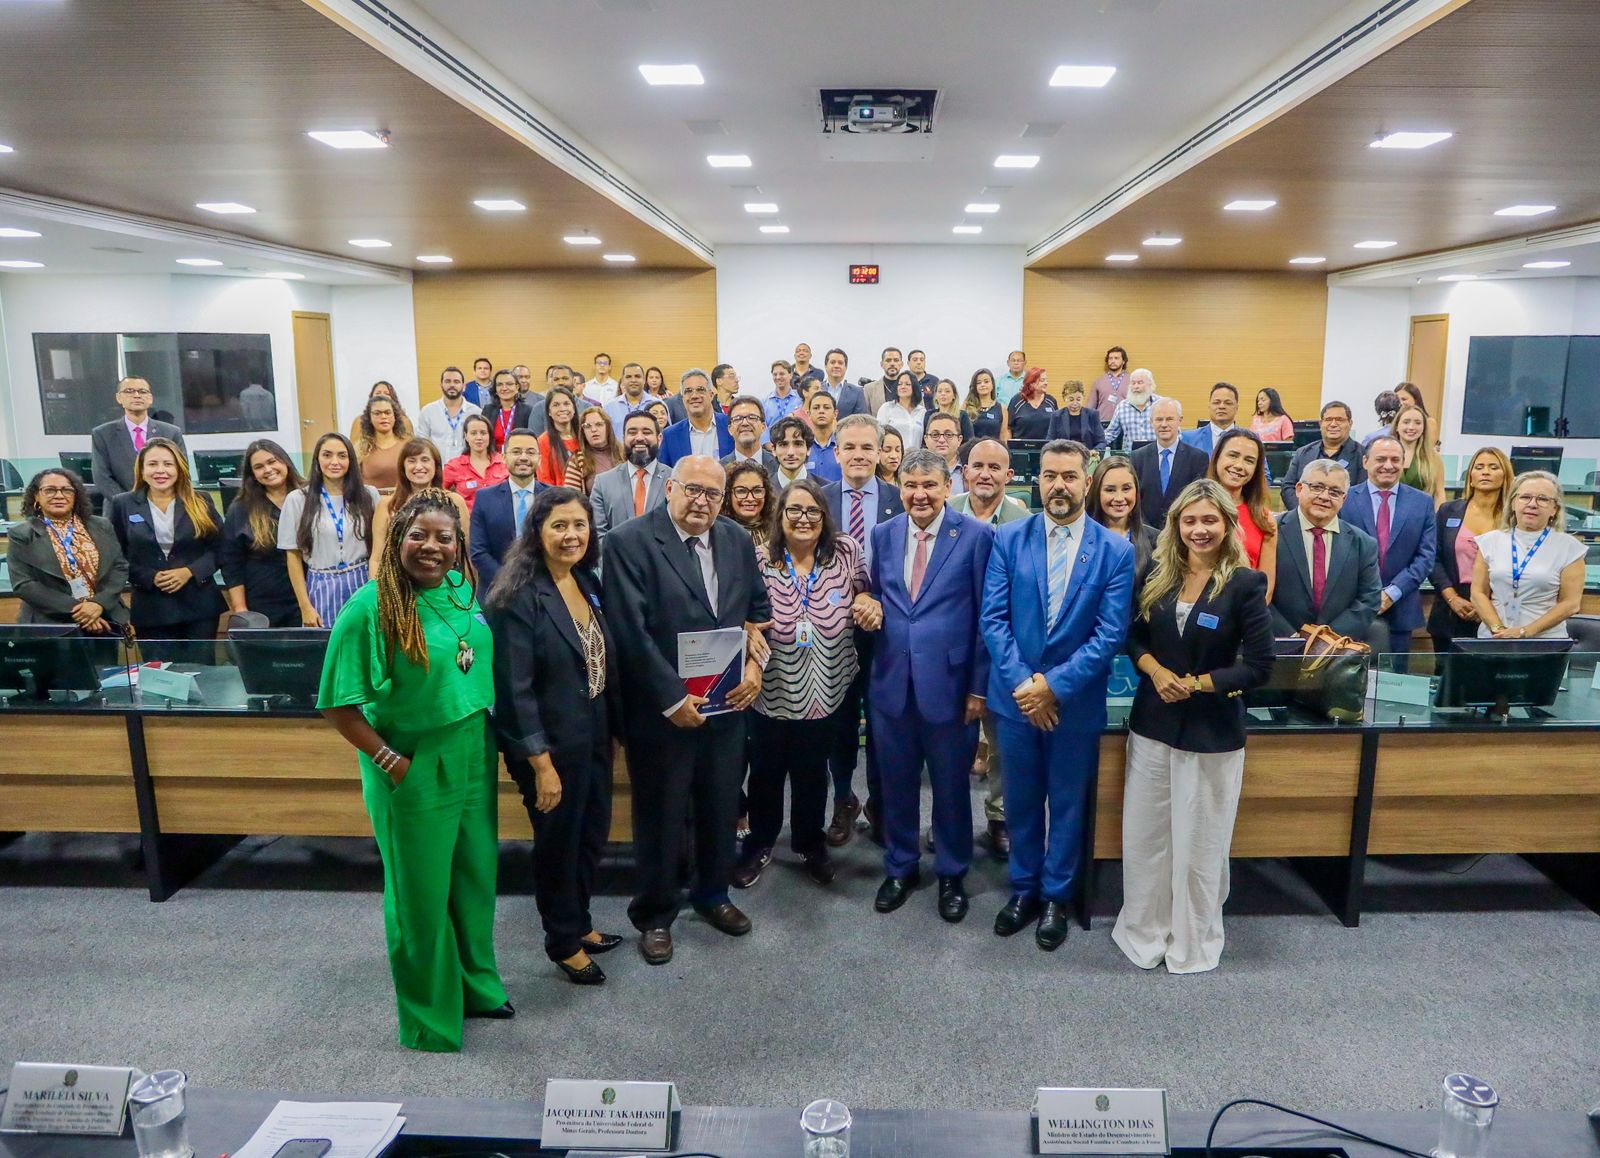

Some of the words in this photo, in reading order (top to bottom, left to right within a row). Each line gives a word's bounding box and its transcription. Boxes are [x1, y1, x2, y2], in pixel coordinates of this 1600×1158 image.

[78, 1091, 109, 1101] SILVA
[545, 1108, 606, 1119] JACQUELINE
[609, 1109, 665, 1119] TAKAHASHI
[1048, 1119, 1125, 1129] WELLINGTON
[1128, 1119, 1154, 1129] DIAS
